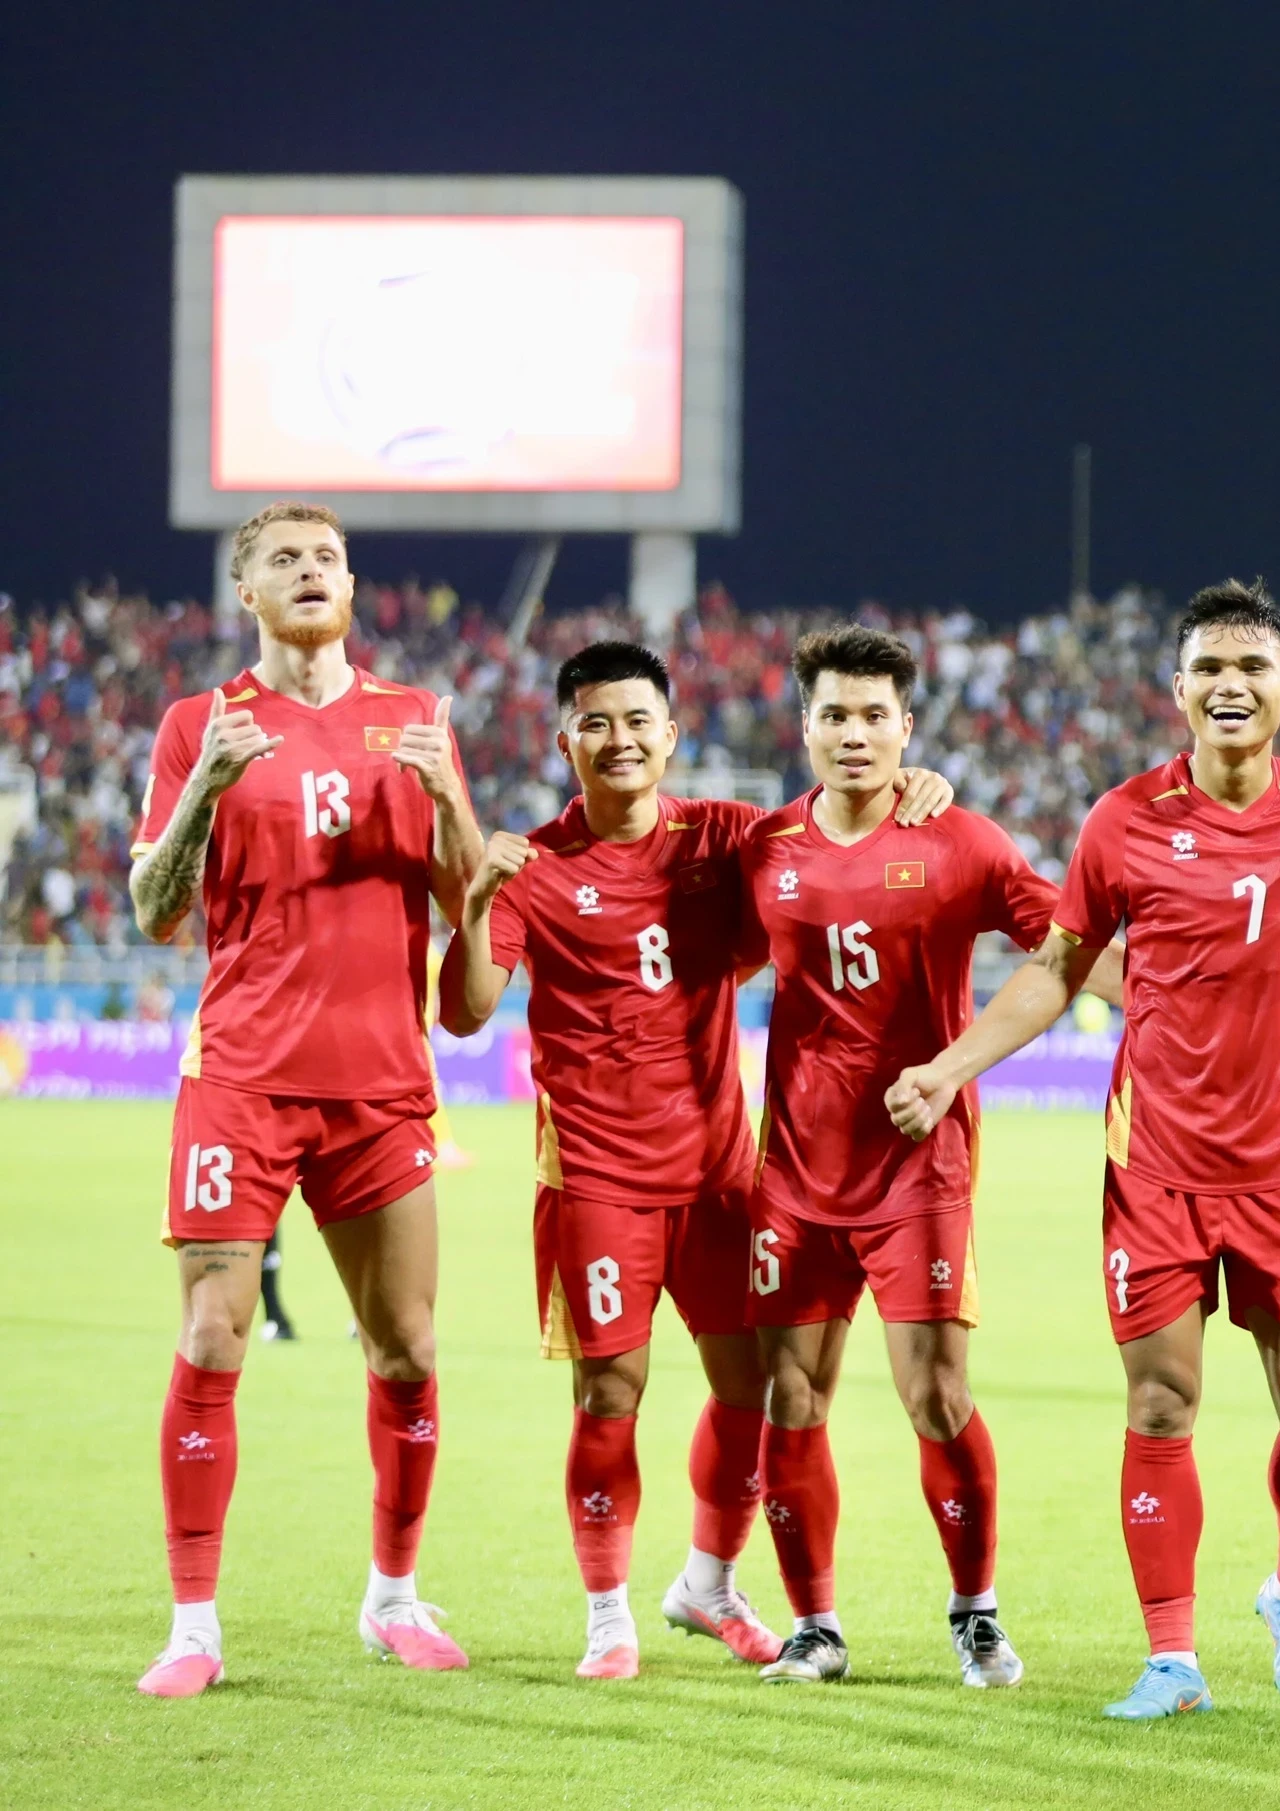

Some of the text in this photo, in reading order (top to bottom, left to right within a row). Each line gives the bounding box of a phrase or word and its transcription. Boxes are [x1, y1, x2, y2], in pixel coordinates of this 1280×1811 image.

[300, 769, 351, 839] 13
[1231, 873, 1267, 945] 7
[635, 922, 674, 993] 8
[826, 919, 880, 992] 15
[184, 1142, 234, 1213] 13
[586, 1255, 623, 1326] 8
[1109, 1247, 1130, 1314] 7
